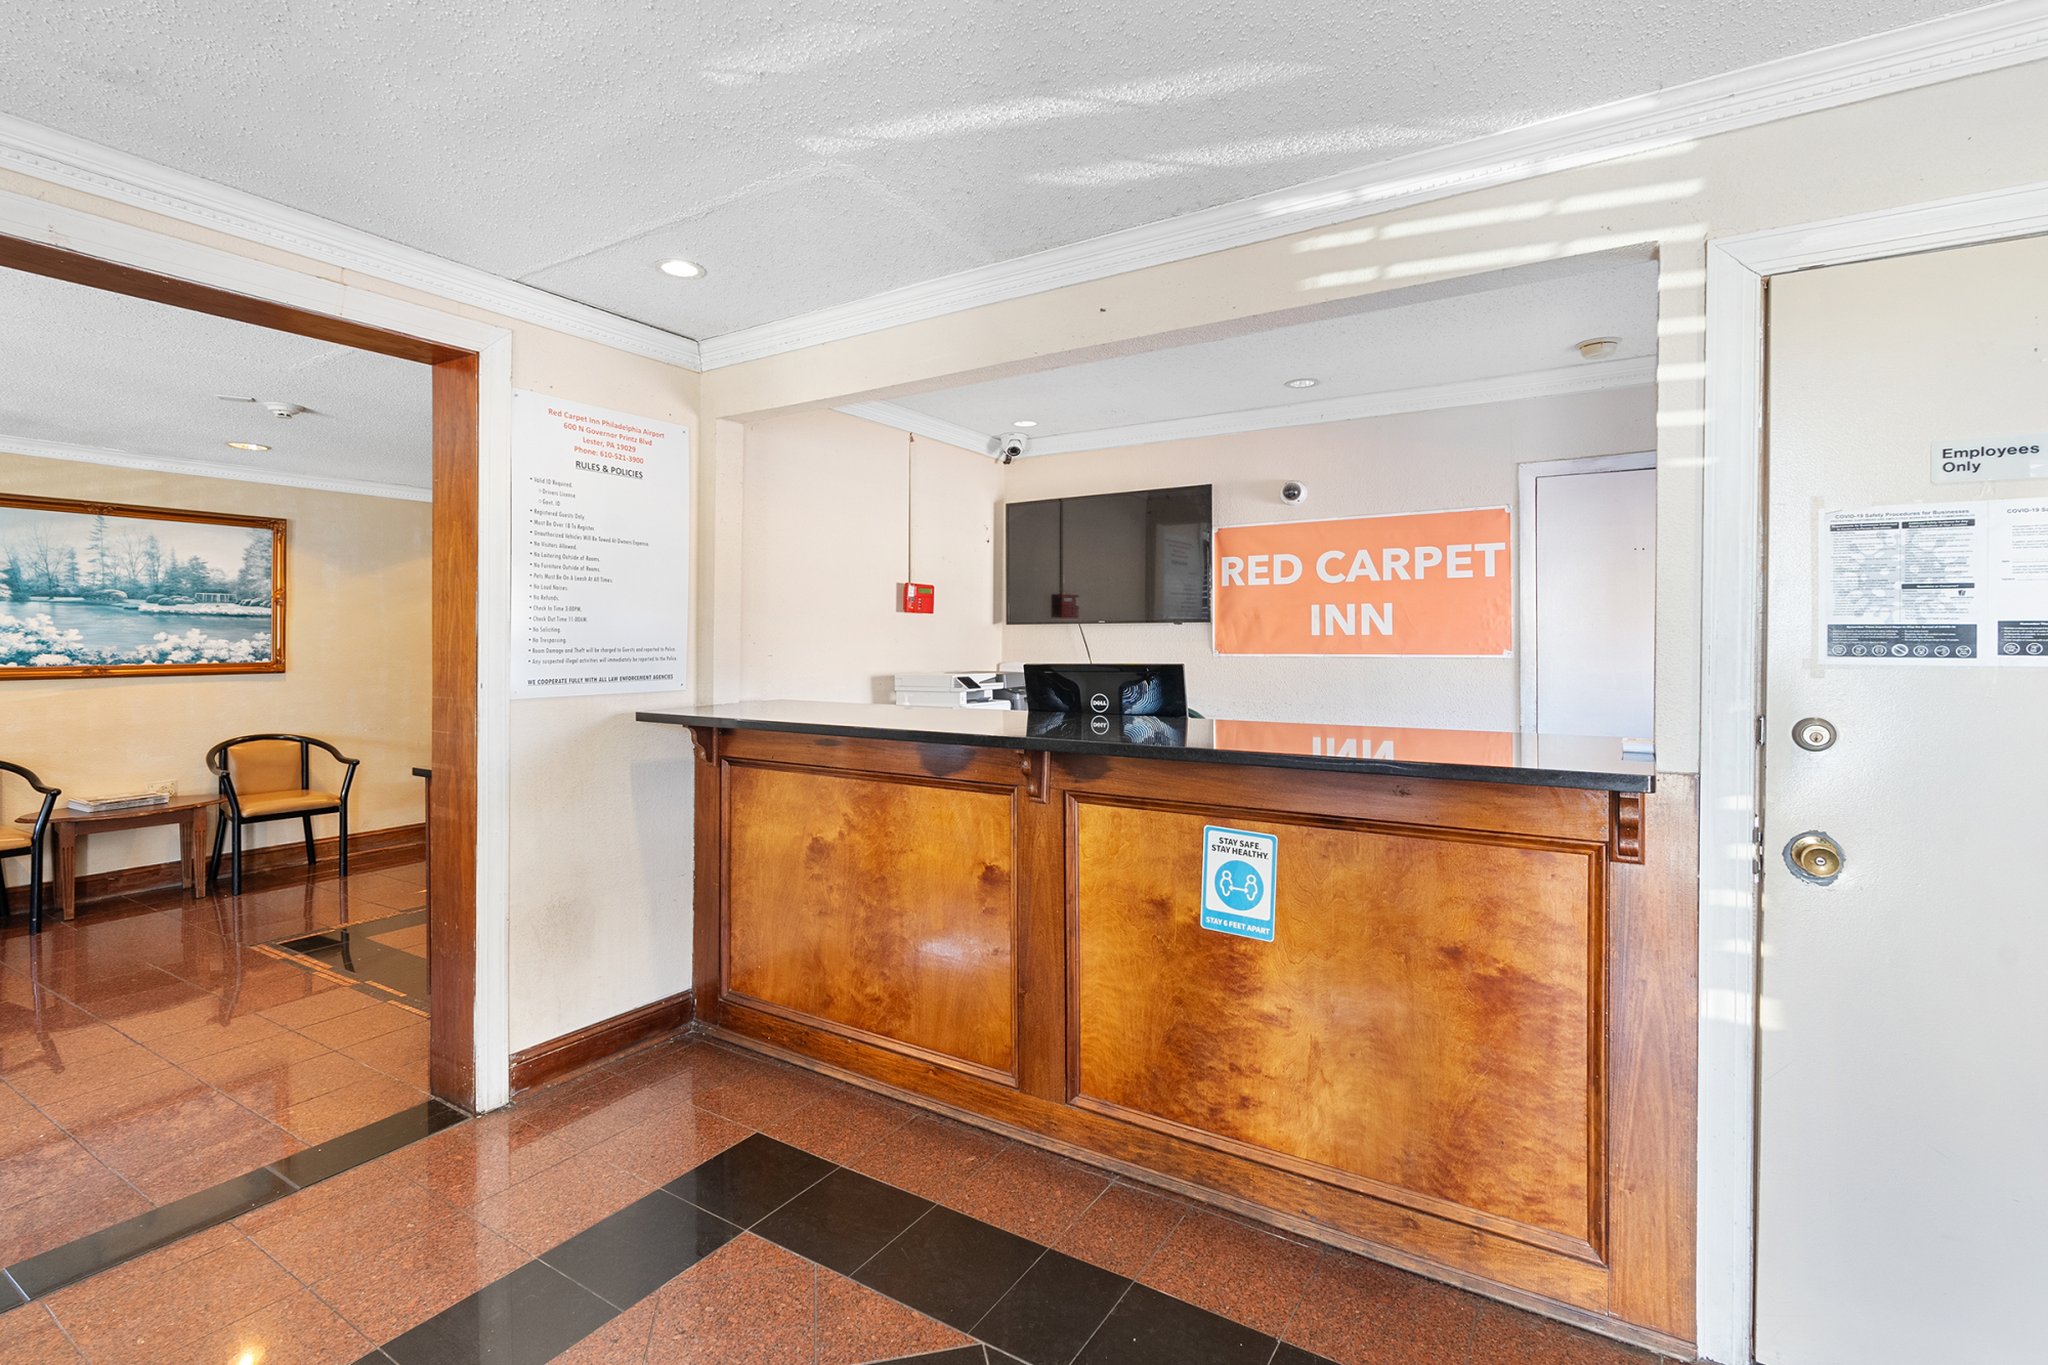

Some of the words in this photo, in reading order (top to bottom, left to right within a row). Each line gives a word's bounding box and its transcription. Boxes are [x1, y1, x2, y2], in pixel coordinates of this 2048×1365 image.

[548, 408, 562, 417] Red
[564, 411, 587, 422] Carpet
[589, 417, 600, 425] Inn
[602, 419, 642, 434] Philadelphia
[643, 428, 665, 439] Airport
[564, 422, 577, 431] 600
[586, 427, 617, 438] Governor
[619, 434, 638, 443] Printz
[639, 437, 653, 446] Blvd
[583, 437, 605, 447] Lester,
[606, 440, 615, 448] PA
[617, 443, 637, 453] 19029
[1942, 444, 2040, 459] Employees
[574, 445, 597, 456] Phone:
[600, 450, 644, 464] 610-521-3900
[575, 460, 600, 472] RULES
[602, 464, 609, 473] &
[611, 466, 644, 479] POLICIES
[1942, 461, 1982, 473] Only
[534, 508, 558, 517] Registered
[553, 520, 564, 528] Over
[541, 541, 558, 549] Visitors
[562, 553, 579, 561] Outside
[1221, 554, 1303, 587] RED
[1315, 542, 1506, 584] CARPET
[533, 572, 544, 580] Pets
[1311, 602, 1393, 636] INN
[565, 657, 579, 665] illegal
[1219, 837, 1238, 846] STAY
[1239, 839, 1262, 850] SAFE.
[1211, 844, 1231, 853] STAY
[1232, 848, 1269, 860] HEALTHY.
[1206, 916, 1222, 925] STAY
[1229, 920, 1246, 930] FEET
[1247, 923, 1271, 935] APART
